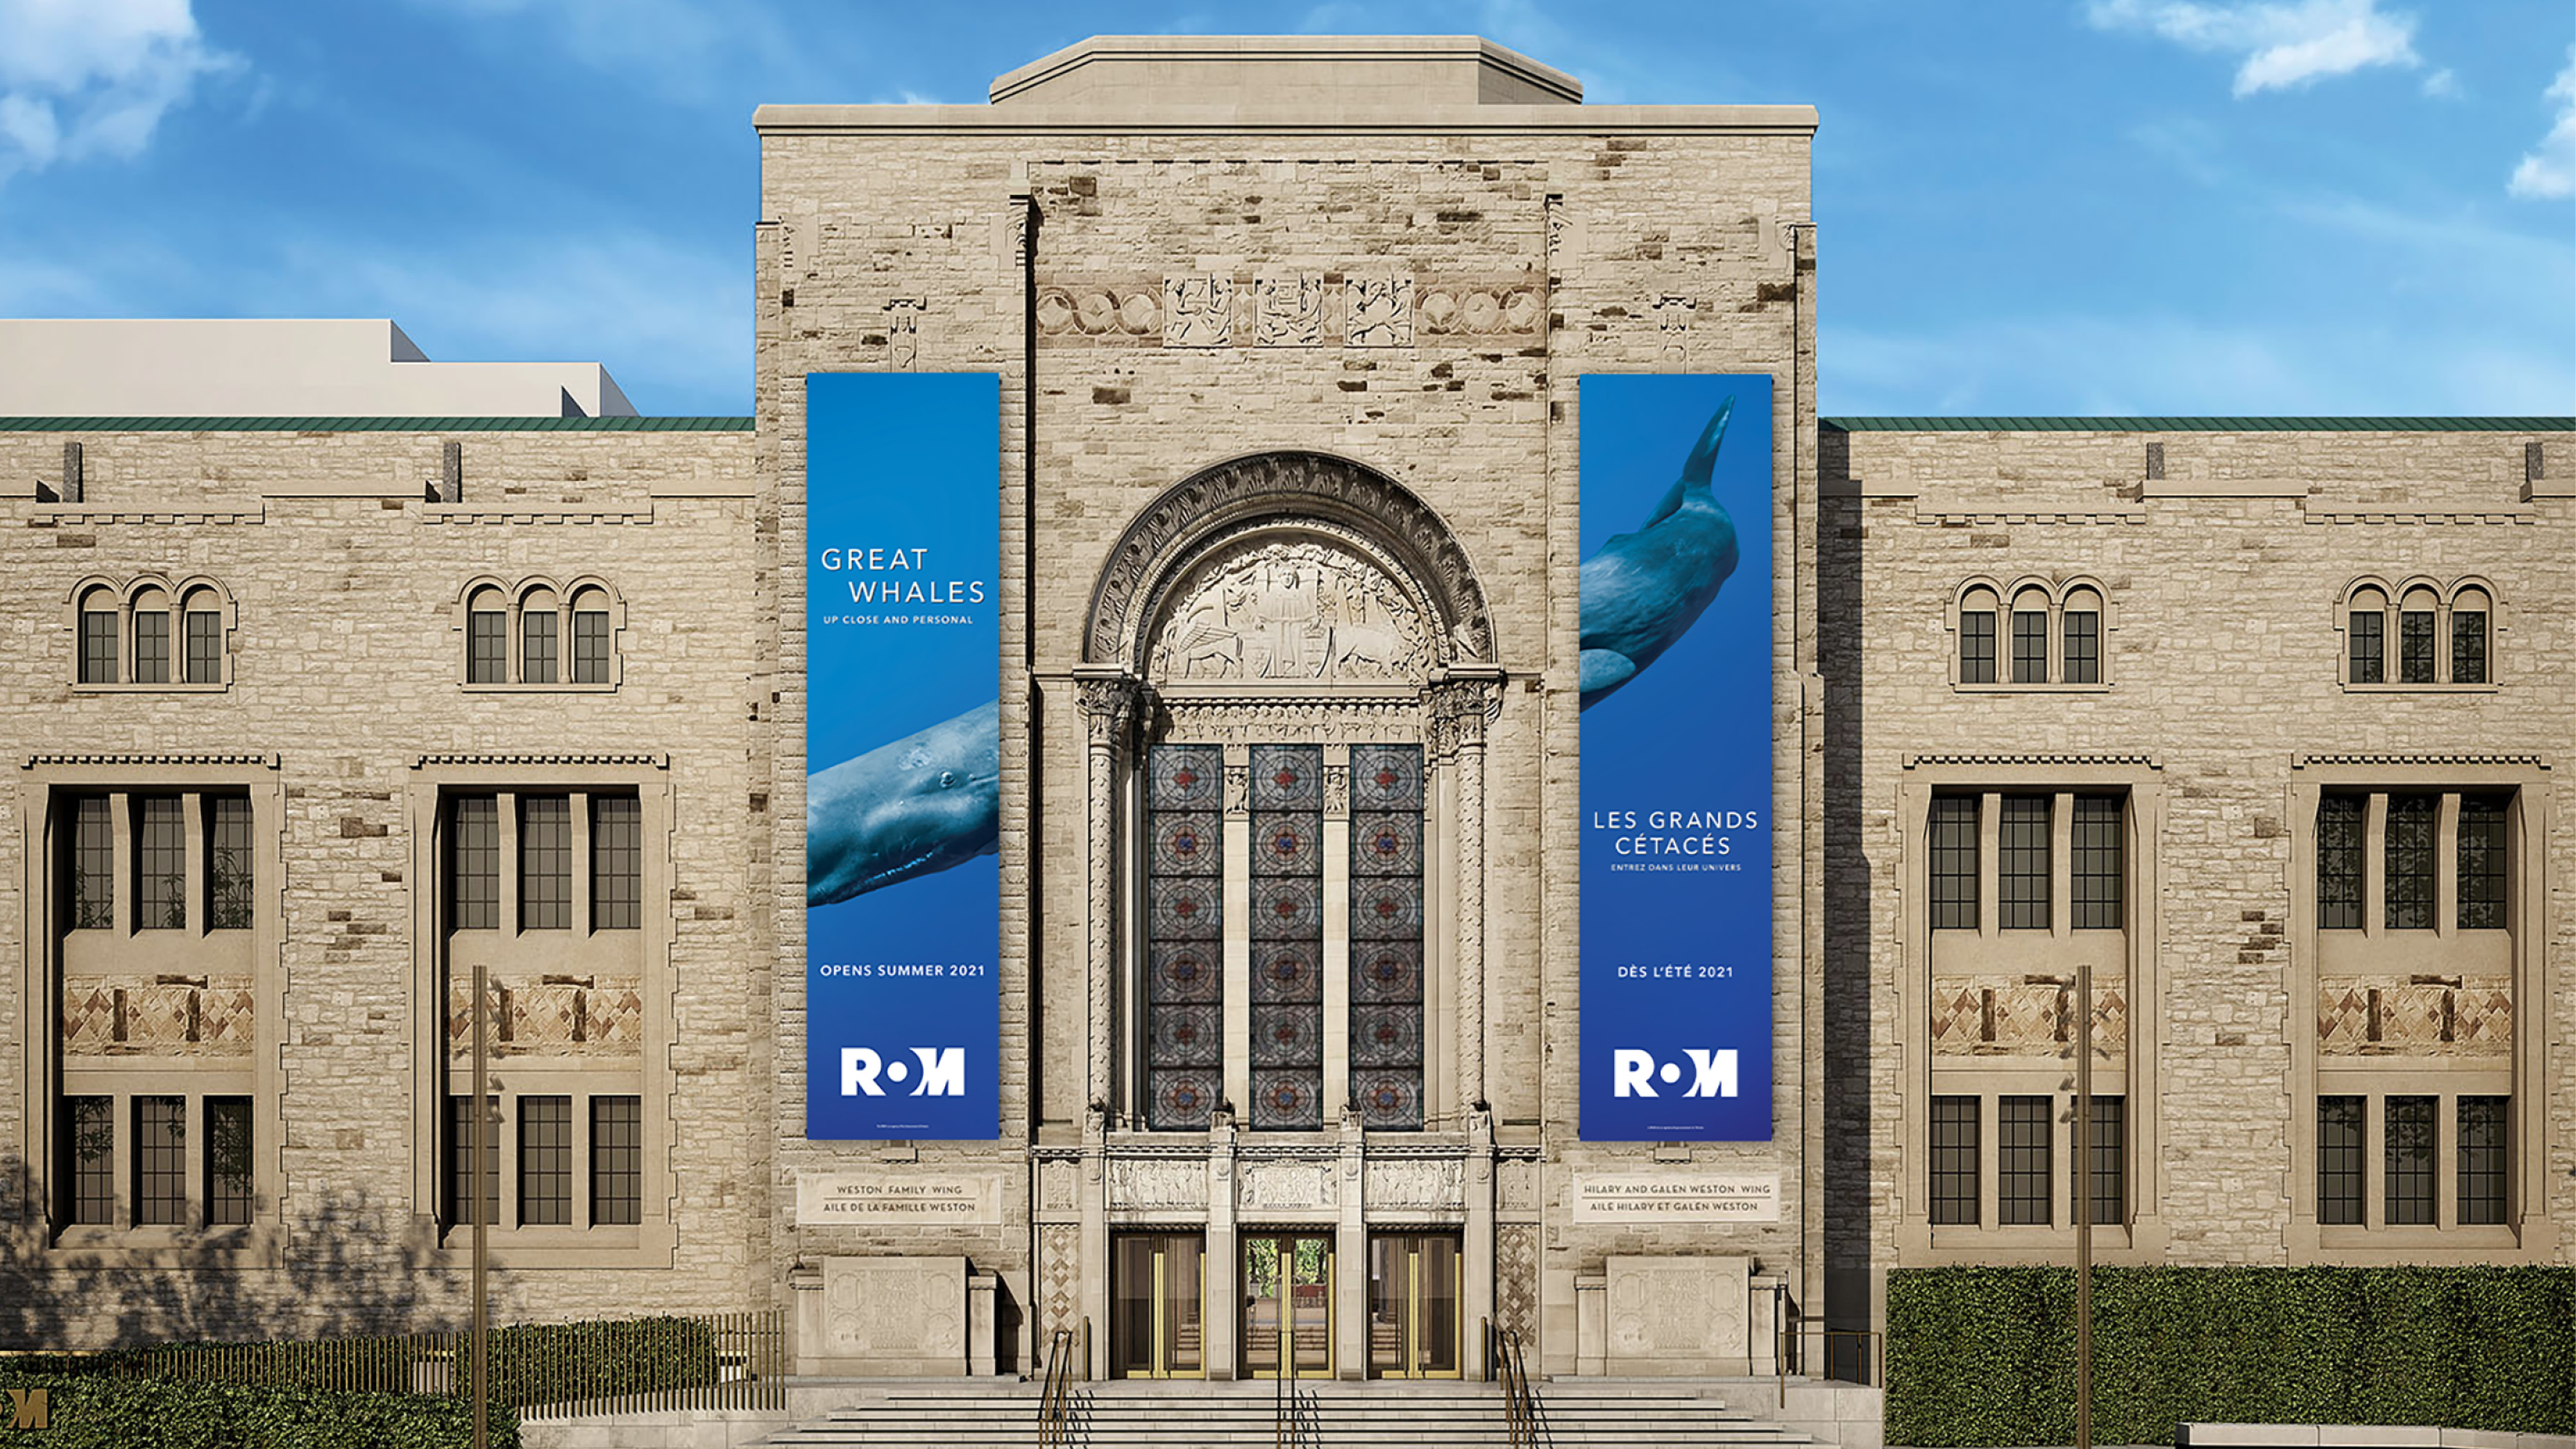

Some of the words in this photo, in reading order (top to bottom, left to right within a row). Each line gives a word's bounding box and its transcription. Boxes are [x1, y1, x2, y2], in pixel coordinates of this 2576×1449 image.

[821, 548, 928, 570] GREAT
[848, 580, 985, 603] WHALES
[823, 616, 838, 625] UP
[842, 615, 879, 625] CLOSE
[883, 616, 909, 625] AND
[913, 615, 974, 625] PERSONAL
[1594, 810, 1637, 829] LES
[1649, 810, 1758, 829] GRANDS
[1615, 832, 1730, 855] CÉTACÉS
[820, 964, 872, 976] OPENS
[877, 964, 943, 976] SUMMER
[949, 964, 985, 976] 2021
[1617, 964, 1647, 978] DÈS
[1653, 964, 1692, 978] L’ÉTÉ
[1699, 966, 1733, 978] 2021
[841, 1048, 965, 1096] ROM
[1614, 1048, 1738, 1097] ROM
[837, 1185, 882, 1194] WESTON
[888, 1185, 926, 1194] FAMILY
[932, 1185, 963, 1194] WING
[1584, 1185, 1622, 1193] HILARY
[1625, 1185, 1648, 1193] AND
[1650, 1185, 1687, 1193] GALEN
[1689, 1185, 1735, 1193] WESTON
[1741, 1185, 1771, 1193] WING
[823, 1203, 848, 1212] AILE
[850, 1203, 864, 1212] DE
[867, 1203, 879, 1212] LA
[882, 1203, 926, 1212] FAMILLE
[930, 1203, 976, 1212] WESTON
[1590, 1203, 1614, 1211] AILE
[1617, 1203, 1655, 1211] HILARY
[1657, 1203, 1671, 1211] ET
[1673, 1203, 1709, 1211] GALEN
[1713, 1203, 1758, 1211] WESTON
